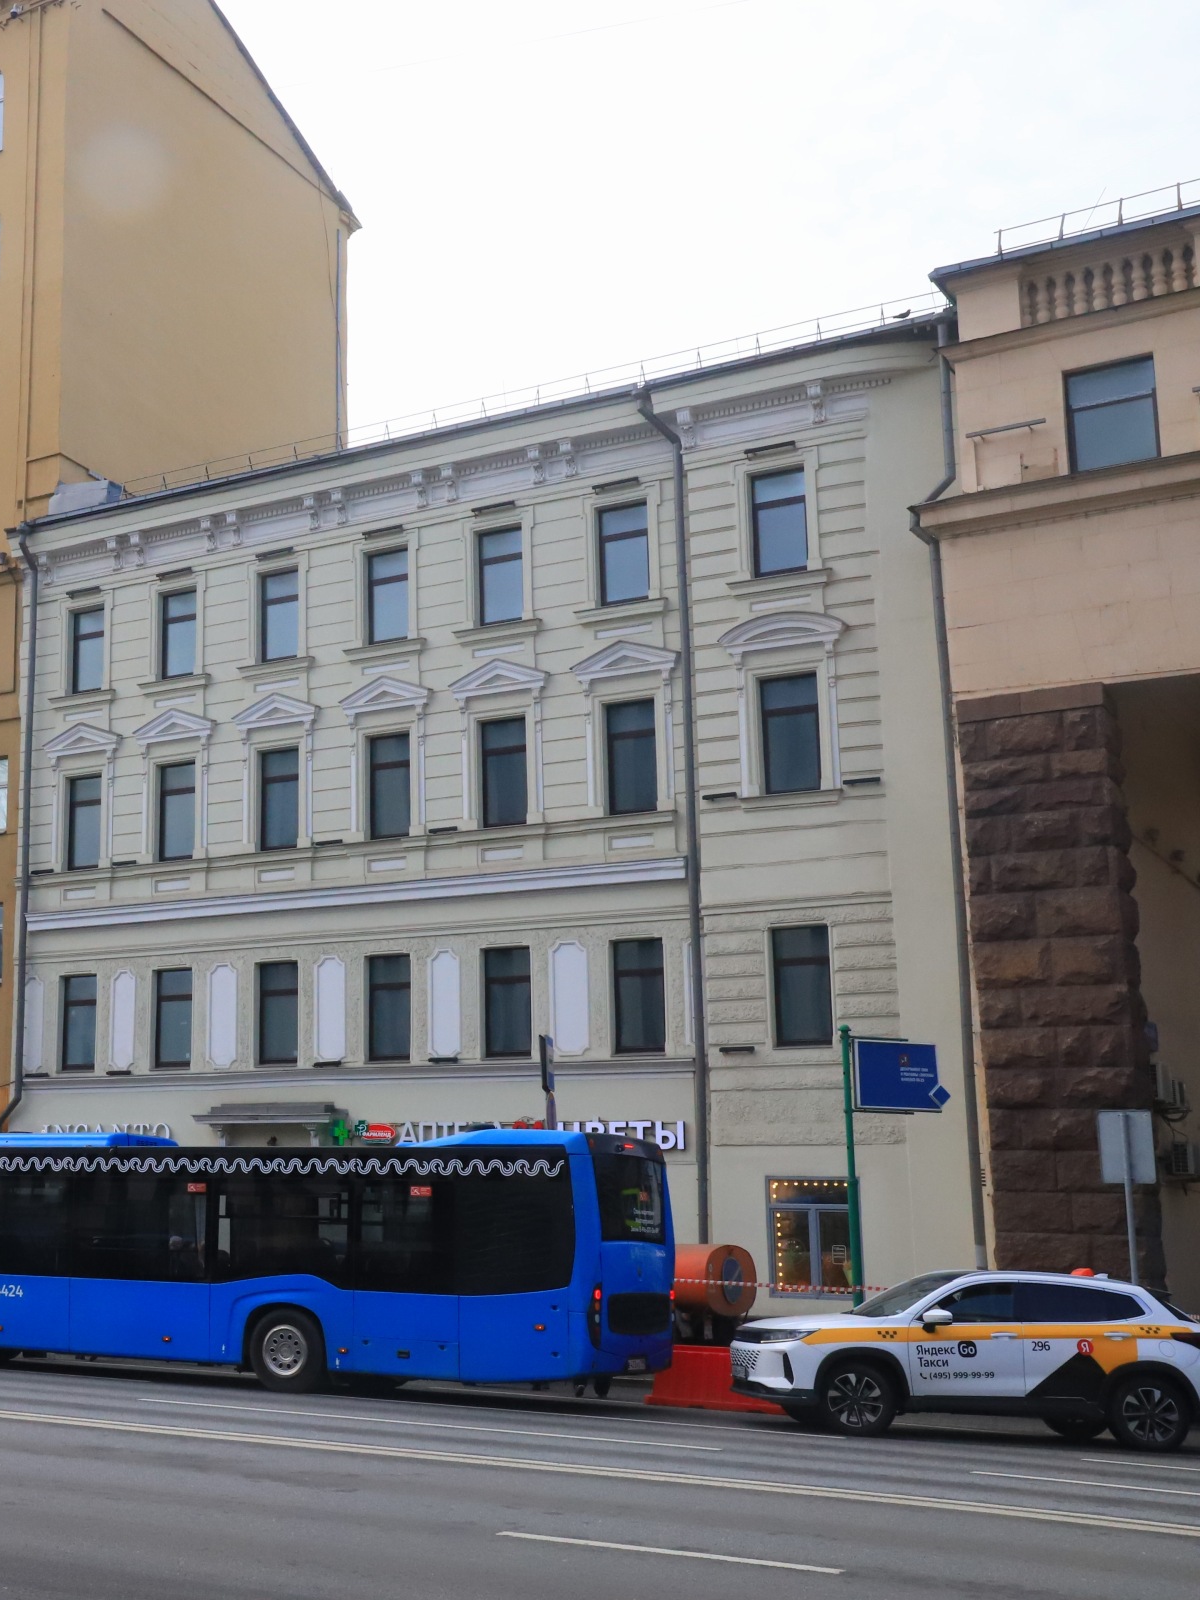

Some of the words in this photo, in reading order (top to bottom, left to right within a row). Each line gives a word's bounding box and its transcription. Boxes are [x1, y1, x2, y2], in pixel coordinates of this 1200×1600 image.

[399, 1120, 502, 1143] АПТЕ
[916, 1344, 956, 1356] Яндекс
[960, 1343, 975, 1355] Go
[1032, 1341, 1050, 1352] 296
[917, 1356, 949, 1368] Такси
[929, 1371, 951, 1380] (495)
[953, 1371, 995, 1379] 999-99-99
